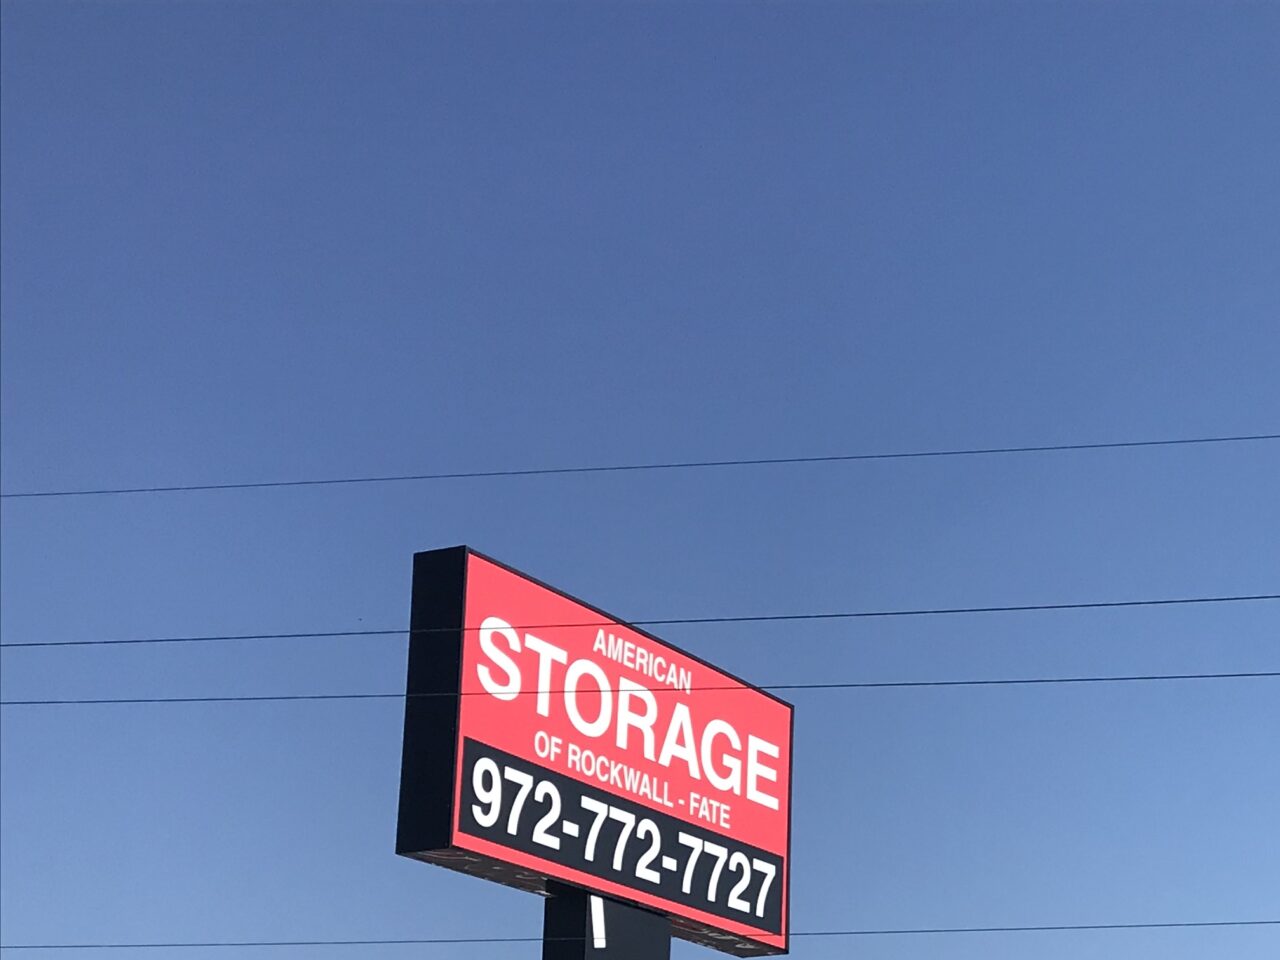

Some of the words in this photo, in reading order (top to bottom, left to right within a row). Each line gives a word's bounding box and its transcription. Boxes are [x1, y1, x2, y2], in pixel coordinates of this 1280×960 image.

[476, 616, 780, 812] STORAGE
[593, 629, 691, 695] AMERICAN
[471, 757, 777, 918] 972-772-7727
[534, 731, 562, 761] OF
[567, 743, 675, 809] ROCKWALL
[689, 797, 731, 829] FATE
